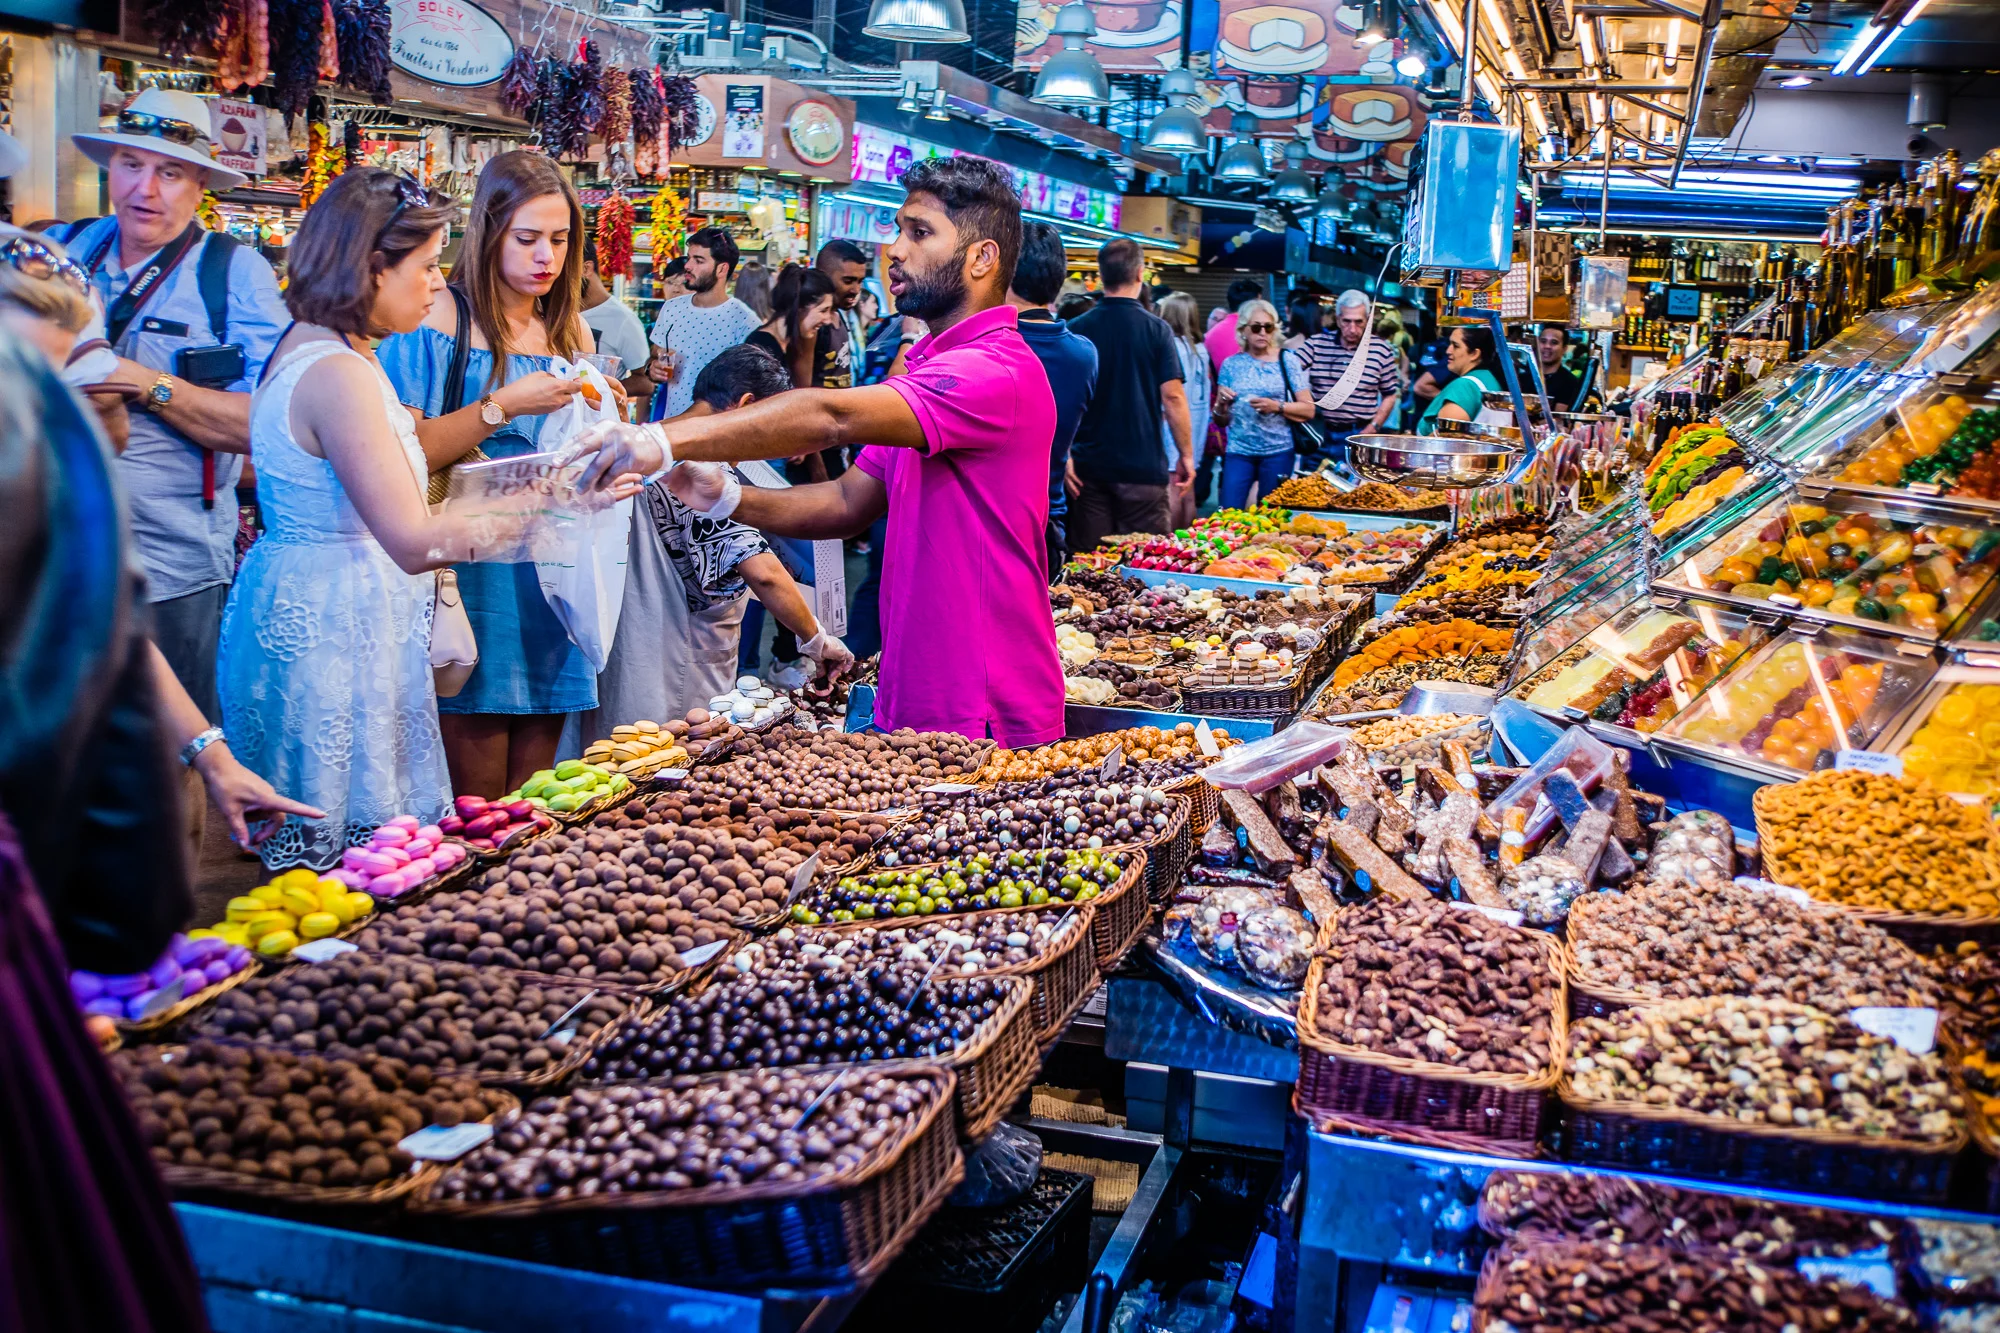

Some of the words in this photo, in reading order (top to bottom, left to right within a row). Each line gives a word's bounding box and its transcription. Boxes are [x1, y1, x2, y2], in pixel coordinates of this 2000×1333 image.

[418, 1, 464, 22] SOLEY
[392, 38, 433, 70] Fruites
[130, 266, 161, 296] Canon
